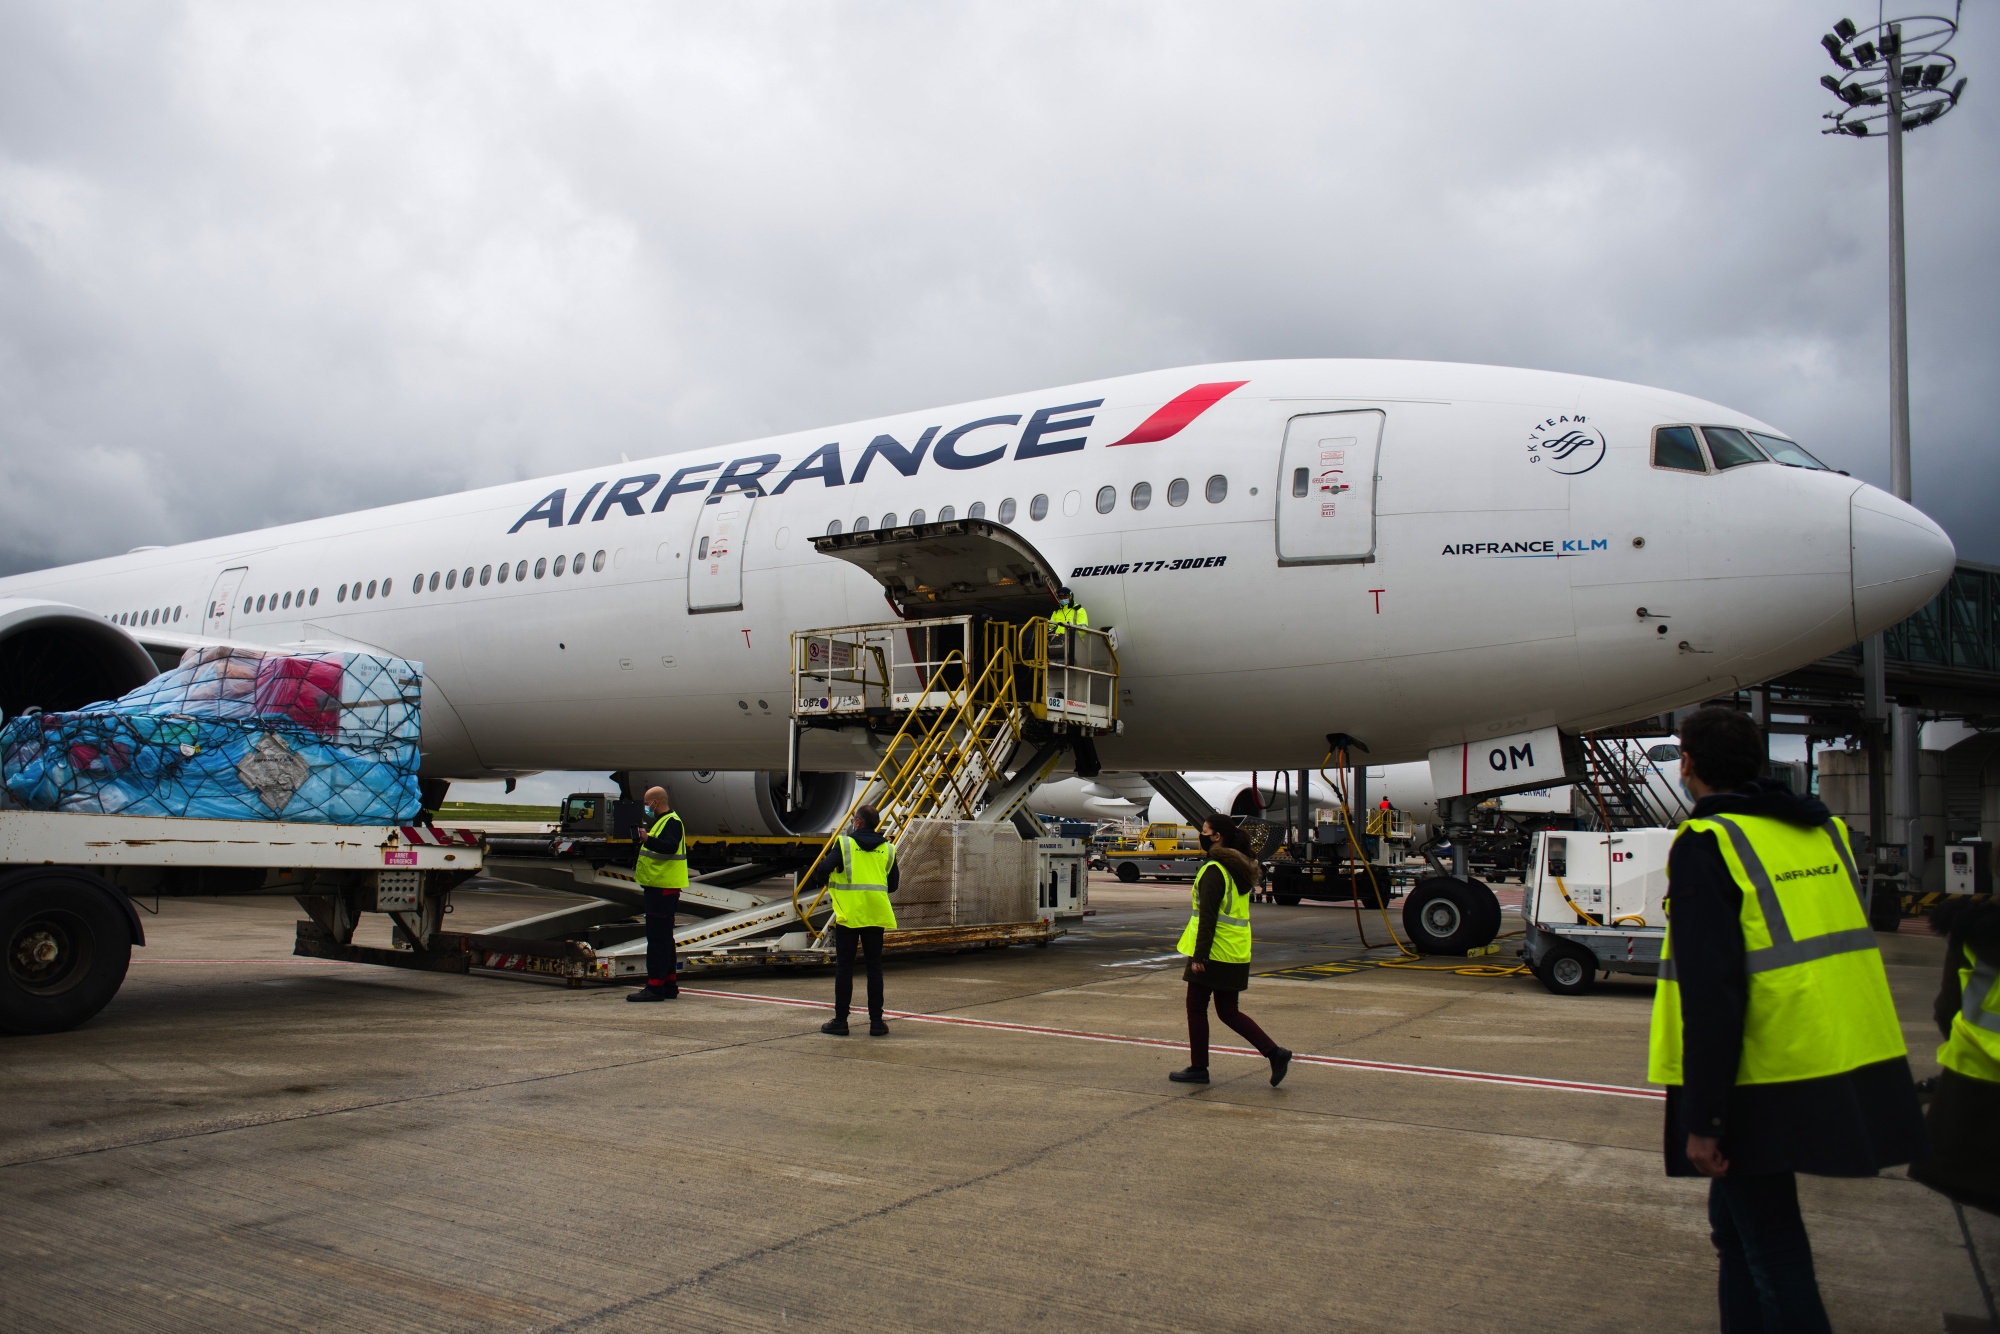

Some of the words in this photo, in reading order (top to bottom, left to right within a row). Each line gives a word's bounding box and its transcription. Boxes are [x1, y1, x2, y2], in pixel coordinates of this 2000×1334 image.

[1527, 414, 1586, 464] SKYTEAM
[507, 398, 1106, 534] AIRFRANCE
[1442, 541, 1554, 556] AIRFRANCE
[1562, 539, 1608, 552] KLM
[1070, 563, 1130, 578] BOEING
[1132, 555, 1228, 574] 777-300ER
[1049, 698, 1060, 707] 082
[1488, 742, 1535, 772] QM
[1774, 865, 1832, 883] AIRFRANCE
